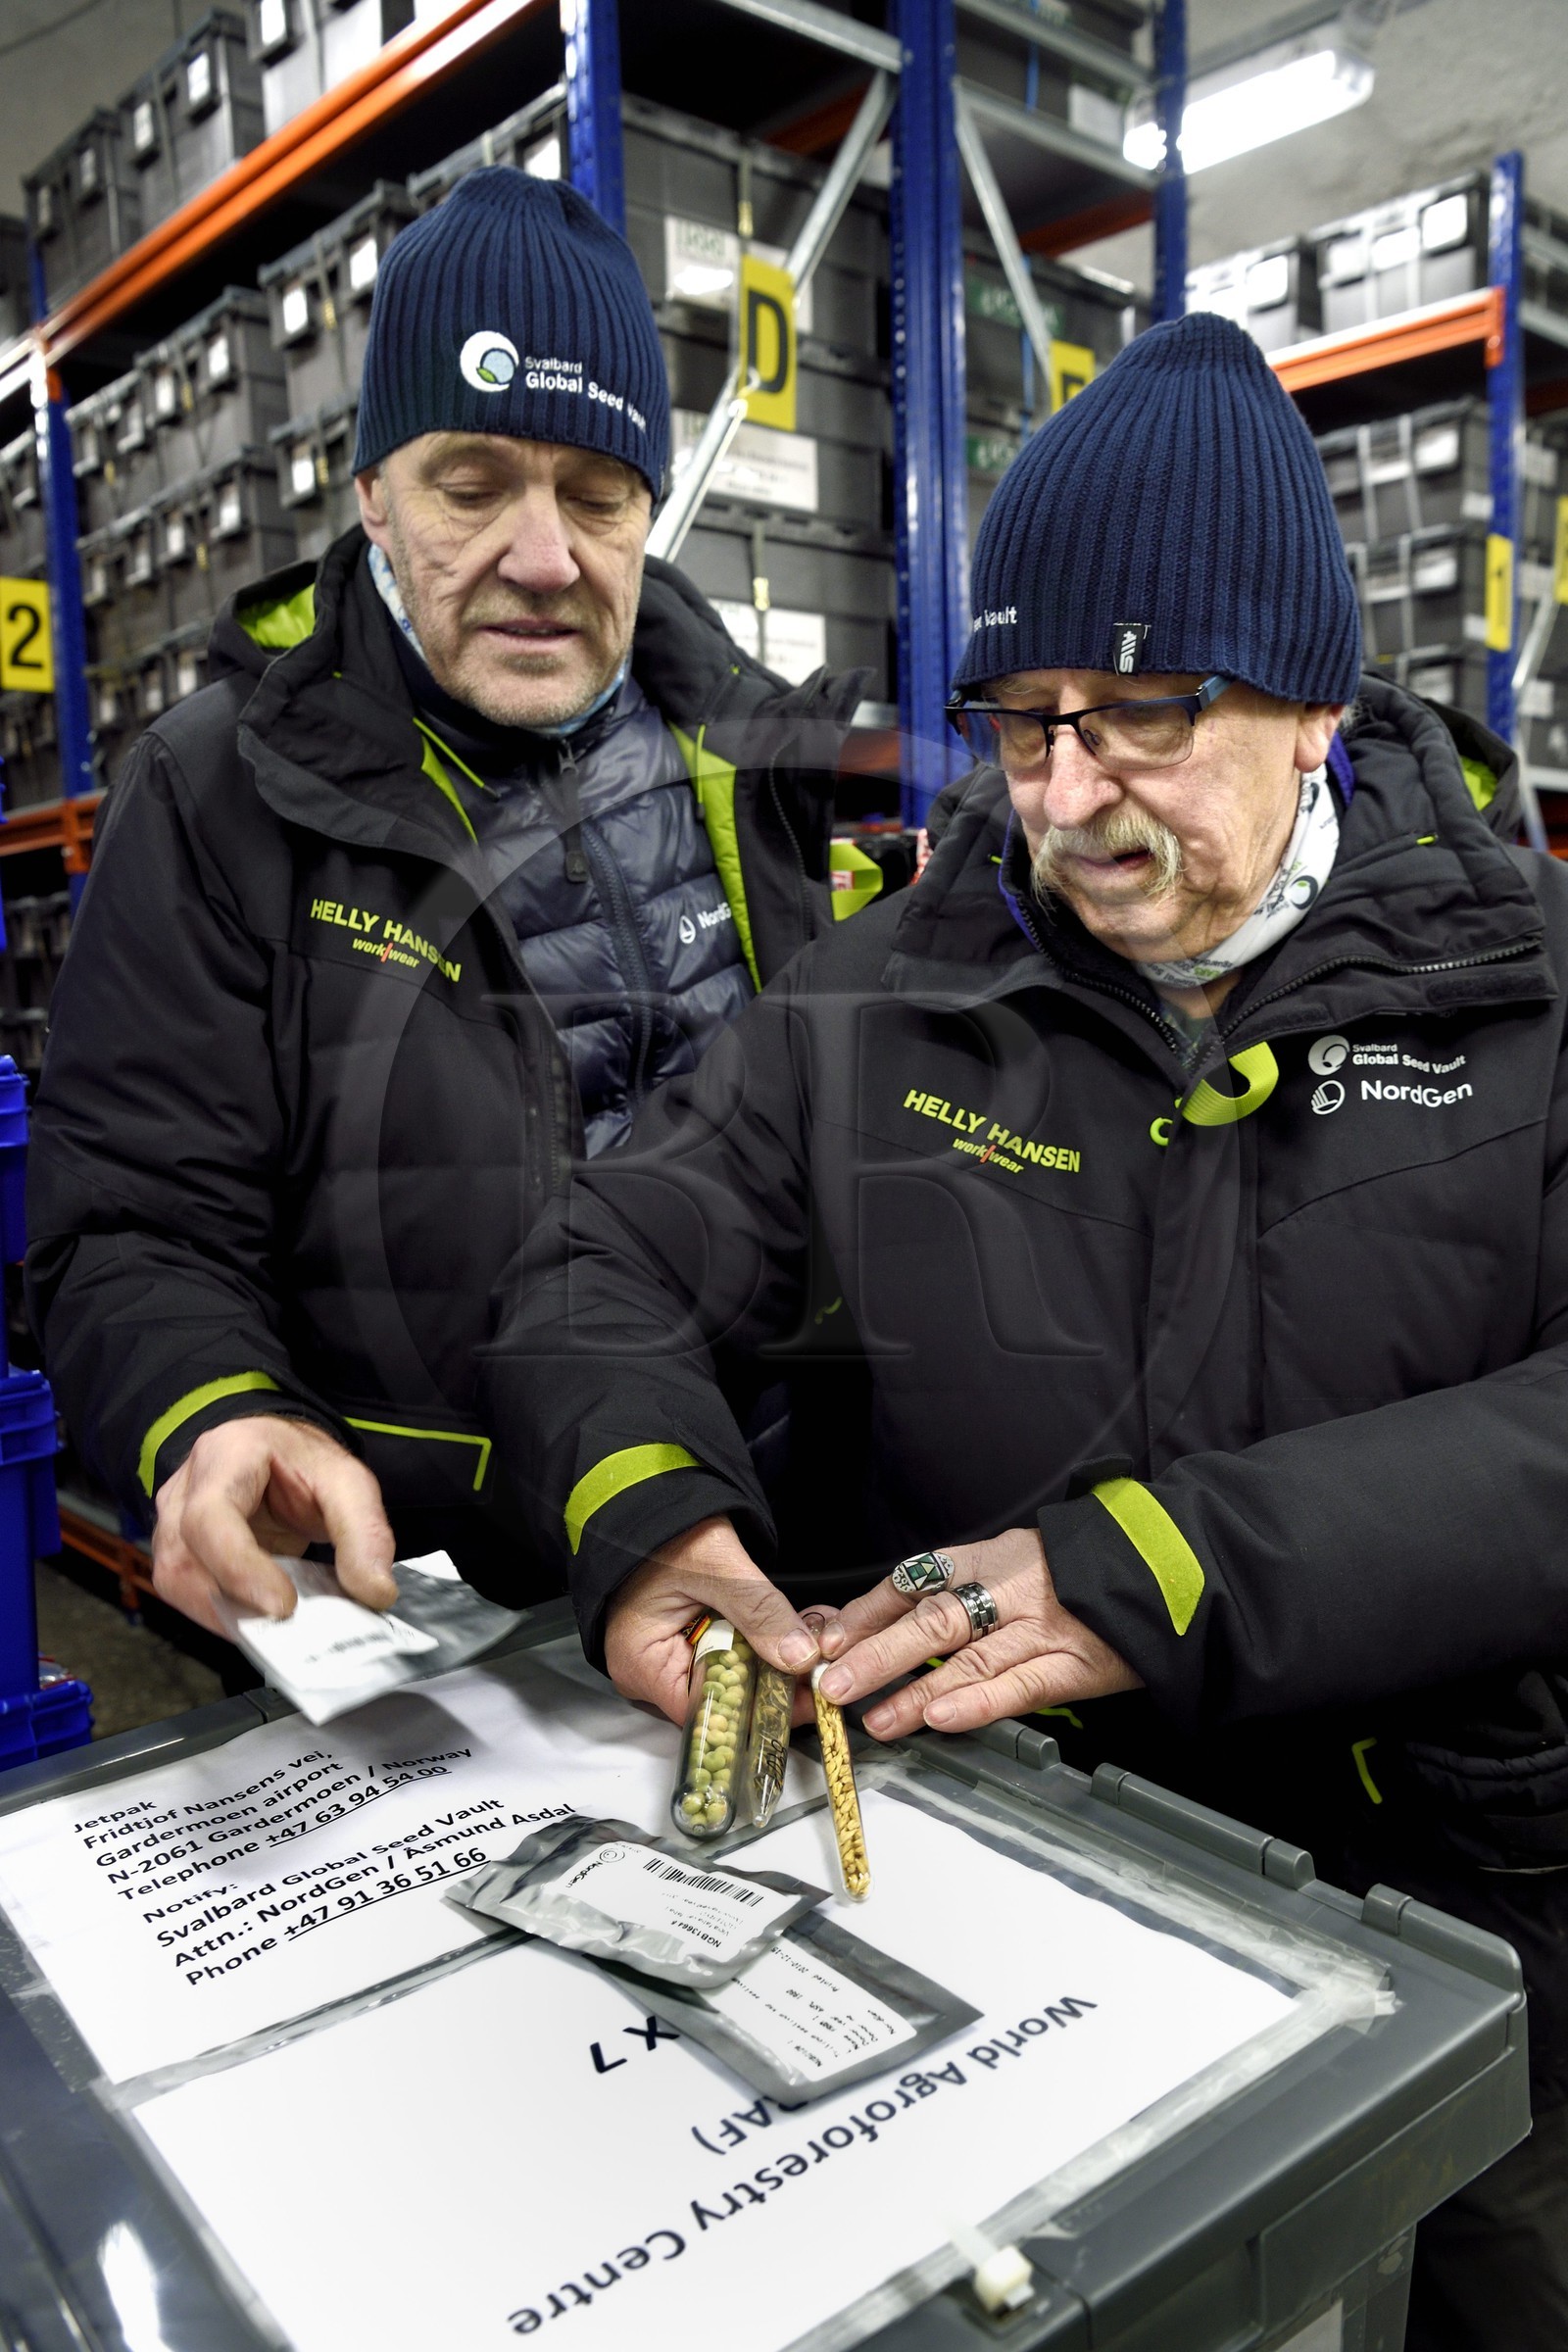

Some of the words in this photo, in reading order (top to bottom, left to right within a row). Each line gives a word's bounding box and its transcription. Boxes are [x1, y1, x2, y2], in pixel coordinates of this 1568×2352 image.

[524, 356, 583, 374] Svalbard
[748, 289, 788, 395] D
[525, 371, 583, 393] Global
[588, 381, 624, 412] Seed
[8, 604, 43, 669] 2
[310, 898, 380, 933] HELLY
[382, 919, 462, 983] HANSEN
[1352, 1044, 1398, 1053] Svalbard
[1352, 1054, 1399, 1065] Global
[1402, 1054, 1431, 1073] Seed
[1432, 1054, 1467, 1074] Vault
[903, 1089, 987, 1134] HELLY
[986, 1122, 1081, 1173] HANSEN
[1360, 1080, 1473, 1108] NordGen
[74, 1799, 157, 1833] Jetpak
[83, 1809, 177, 1848] Fridtjof
[183, 1769, 285, 1814] Nansens
[288, 1750, 332, 1769] vei,
[96, 1805, 258, 1867] Gardermoen
[263, 1761, 343, 1807] airport
[107, 1841, 204, 1885] N-2061
[208, 1773, 361, 1843] Gardermoen
[380, 1747, 472, 1771] Norway
[118, 1840, 260, 1901] Telephone
[265, 1821, 308, 1843] +47
[315, 1803, 346, 1823] 63
[348, 1785, 381, 1806] 94
[383, 1771, 414, 1788] 54
[416, 1766, 449, 1776] 00
[142, 1884, 239, 1924] Notify:
[156, 1884, 277, 1947] Svalbard
[281, 1851, 368, 1886] Global
[371, 1824, 435, 1854] Seed
[435, 1797, 505, 1827] Vault
[174, 1921, 254, 1968] Attn.:
[257, 1866, 380, 1923] NordGen
[405, 1816, 507, 1860] Åsmund
[511, 1803, 576, 1825] Asdal
[566, 1860, 603, 1888] NordGen
[185, 1936, 278, 1985] Phone
[283, 1905, 329, 1937] +47
[337, 1889, 374, 1910] 91
[376, 1874, 413, 1895] 36
[414, 1859, 451, 1882] 51
[453, 1847, 487, 1868] 66
[590, 2041, 628, 2075] 7
[967, 1995, 1099, 2072] World
[690, 2061, 969, 2231] Agroforestry
[507, 2229, 687, 2336] Centre
